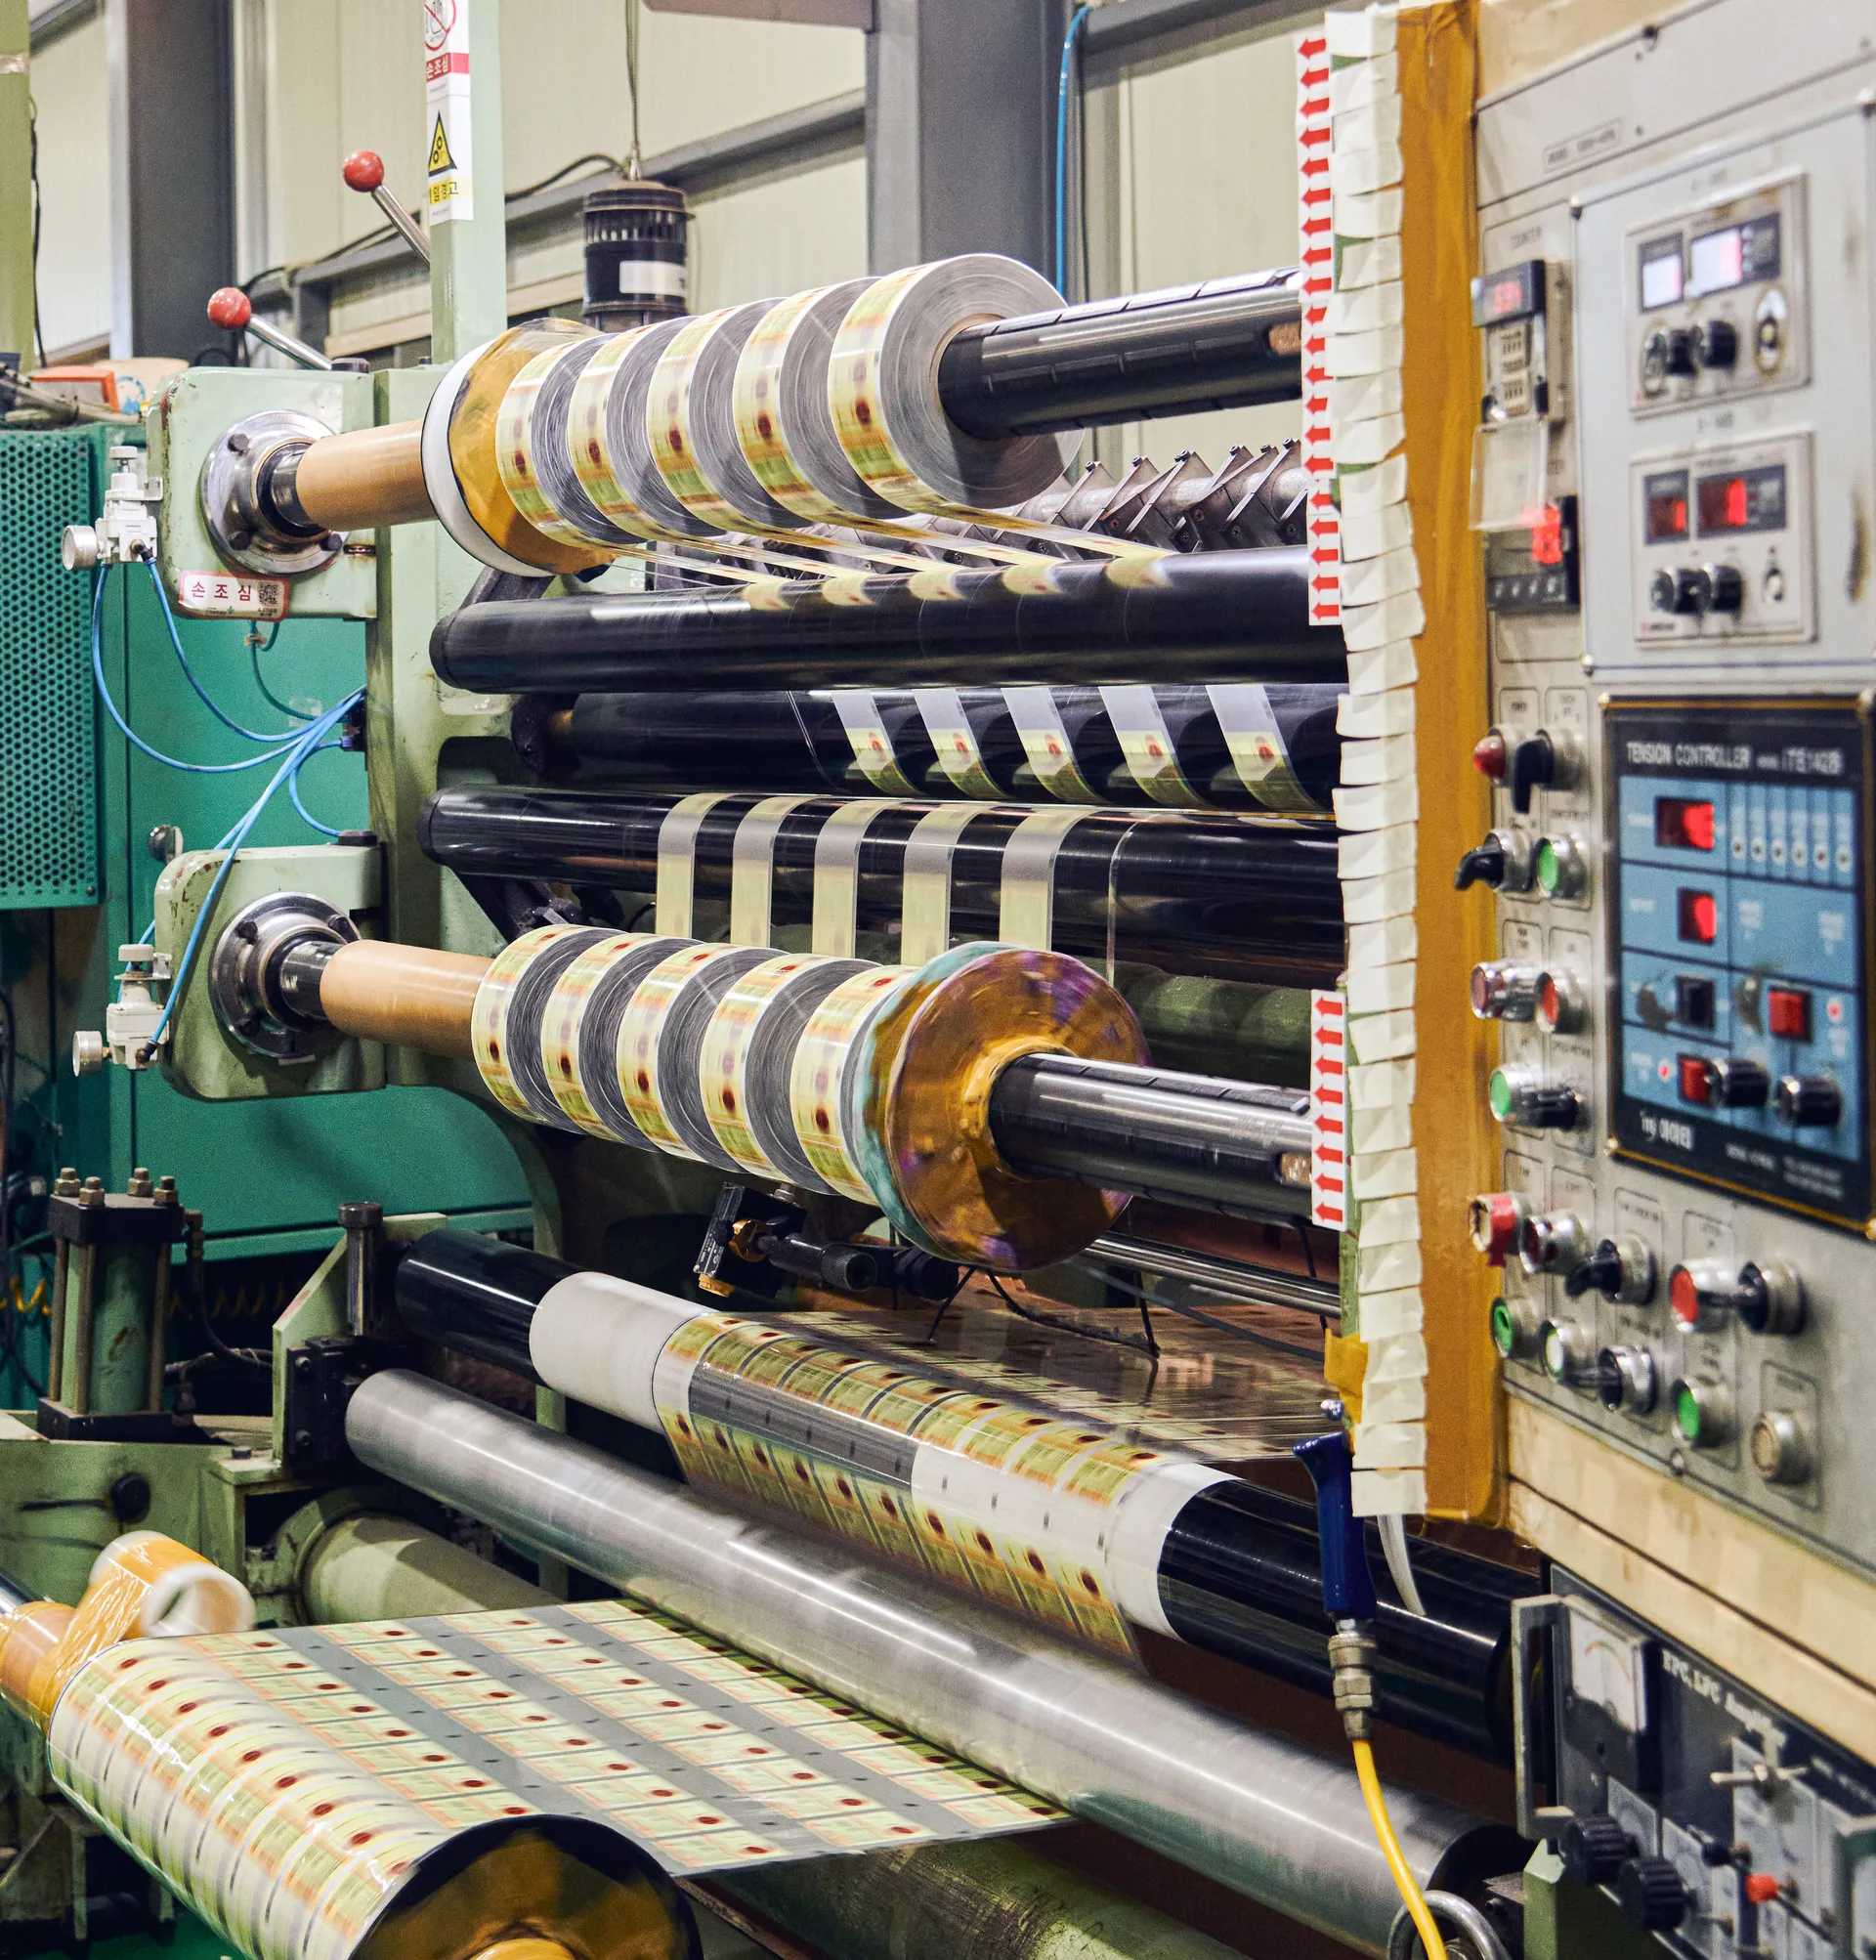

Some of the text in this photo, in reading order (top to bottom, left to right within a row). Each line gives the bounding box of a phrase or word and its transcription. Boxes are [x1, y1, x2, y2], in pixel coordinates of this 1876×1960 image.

[426, 54, 448, 80] 손조심
[429, 181, 459, 203] 임경고
[1627, 741, 1672, 765] TENSION
[1675, 743, 1751, 769] CONTROLLER
